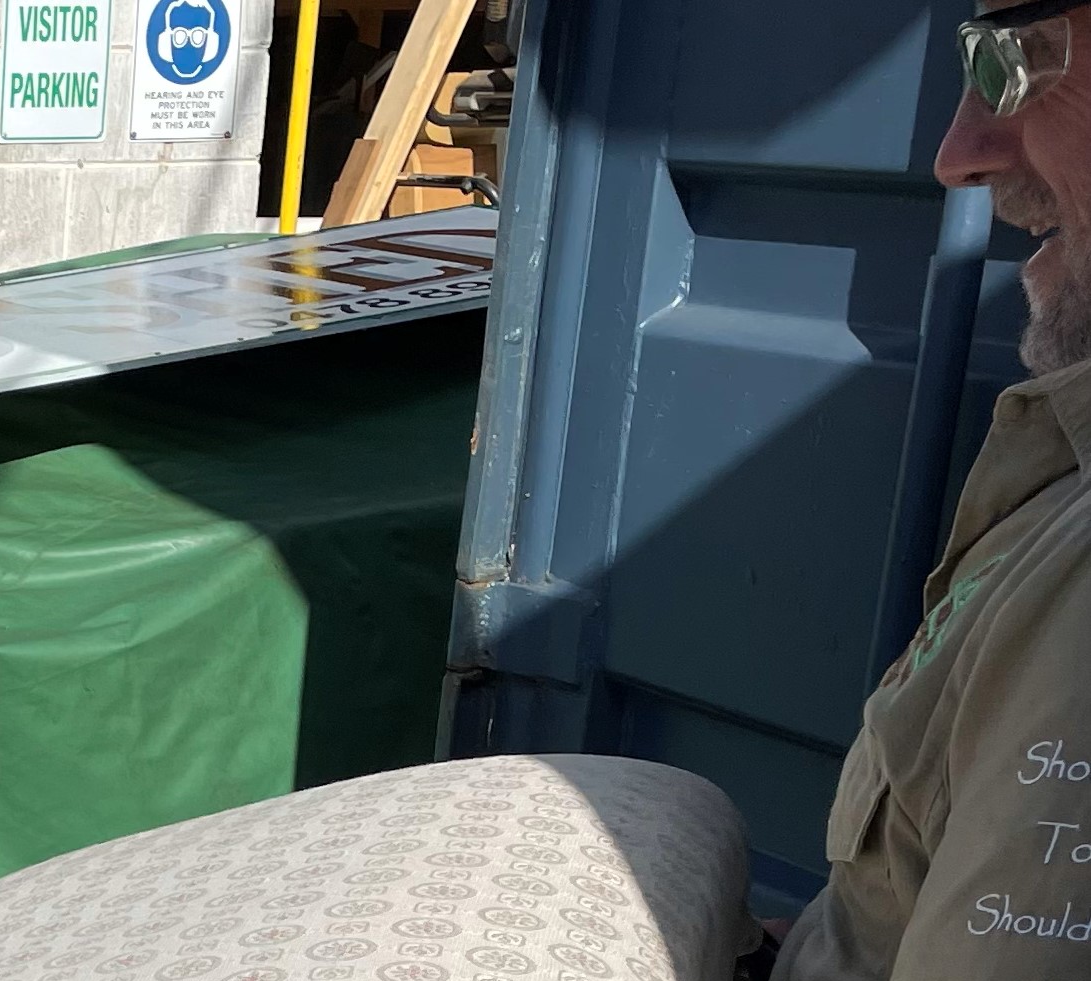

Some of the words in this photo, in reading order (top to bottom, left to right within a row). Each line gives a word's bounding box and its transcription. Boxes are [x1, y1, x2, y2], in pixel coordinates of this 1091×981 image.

[19, 5, 98, 42] VISITOR
[10, 71, 99, 108] PARKING
[144, 91, 182, 100] HEARING
[186, 90, 204, 99] AND
[207, 90, 225, 99] EYE
[158, 101, 210, 109] PROTECTION
[150, 111, 174, 120] MUST
[177, 111, 188, 119] BE
[192, 110, 216, 119] WORN
[152, 121, 161, 129] IN
[165, 121, 184, 129] THIS
[187, 120, 210, 129] AREA
[408, 276, 493, 299] 89
